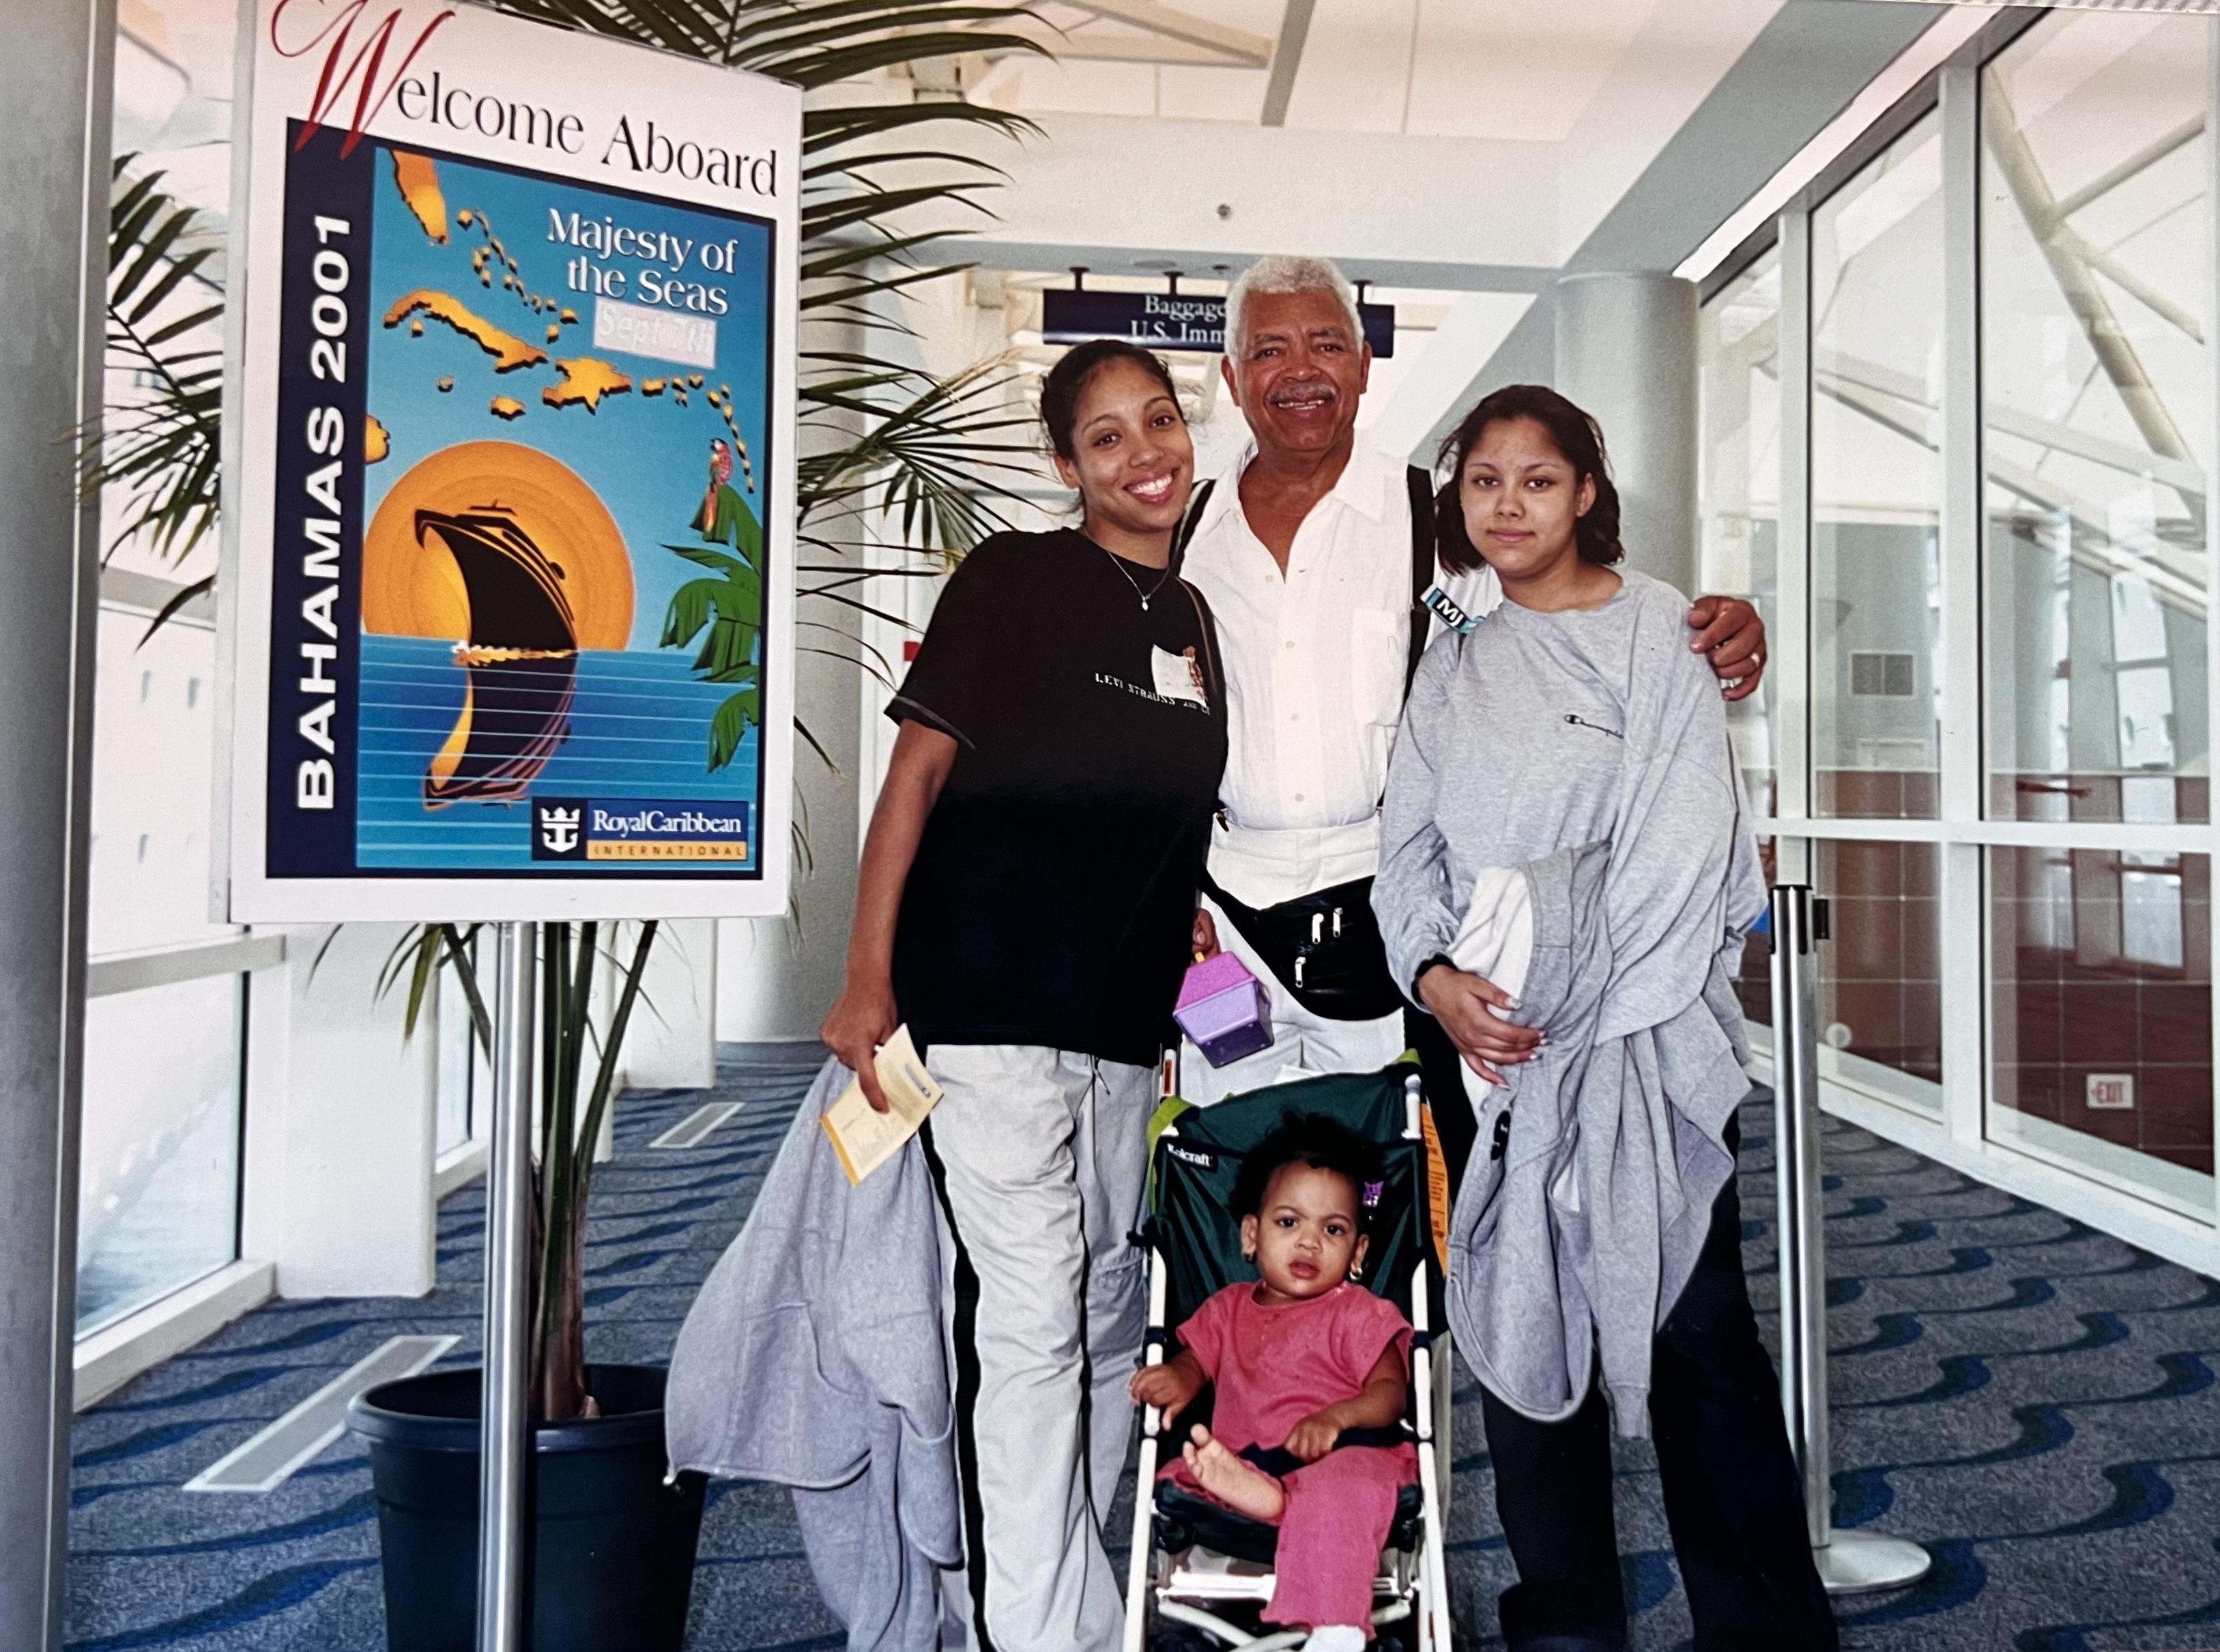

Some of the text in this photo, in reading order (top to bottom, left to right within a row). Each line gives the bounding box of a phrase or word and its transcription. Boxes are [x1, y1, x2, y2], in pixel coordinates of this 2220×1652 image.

[271, 0, 778, 197] Welcome Aboard
[547, 207, 739, 274] Majesty of
[567, 256, 729, 315] the Seas
[298, 215, 350, 809] BAHAMAS 2001
[1436, 598, 1465, 627] MJ
[1095, 673, 1123, 689] LEVI
[1127, 683, 1176, 706] STRAUSS
[594, 845, 743, 856] INTERNATIONAL
